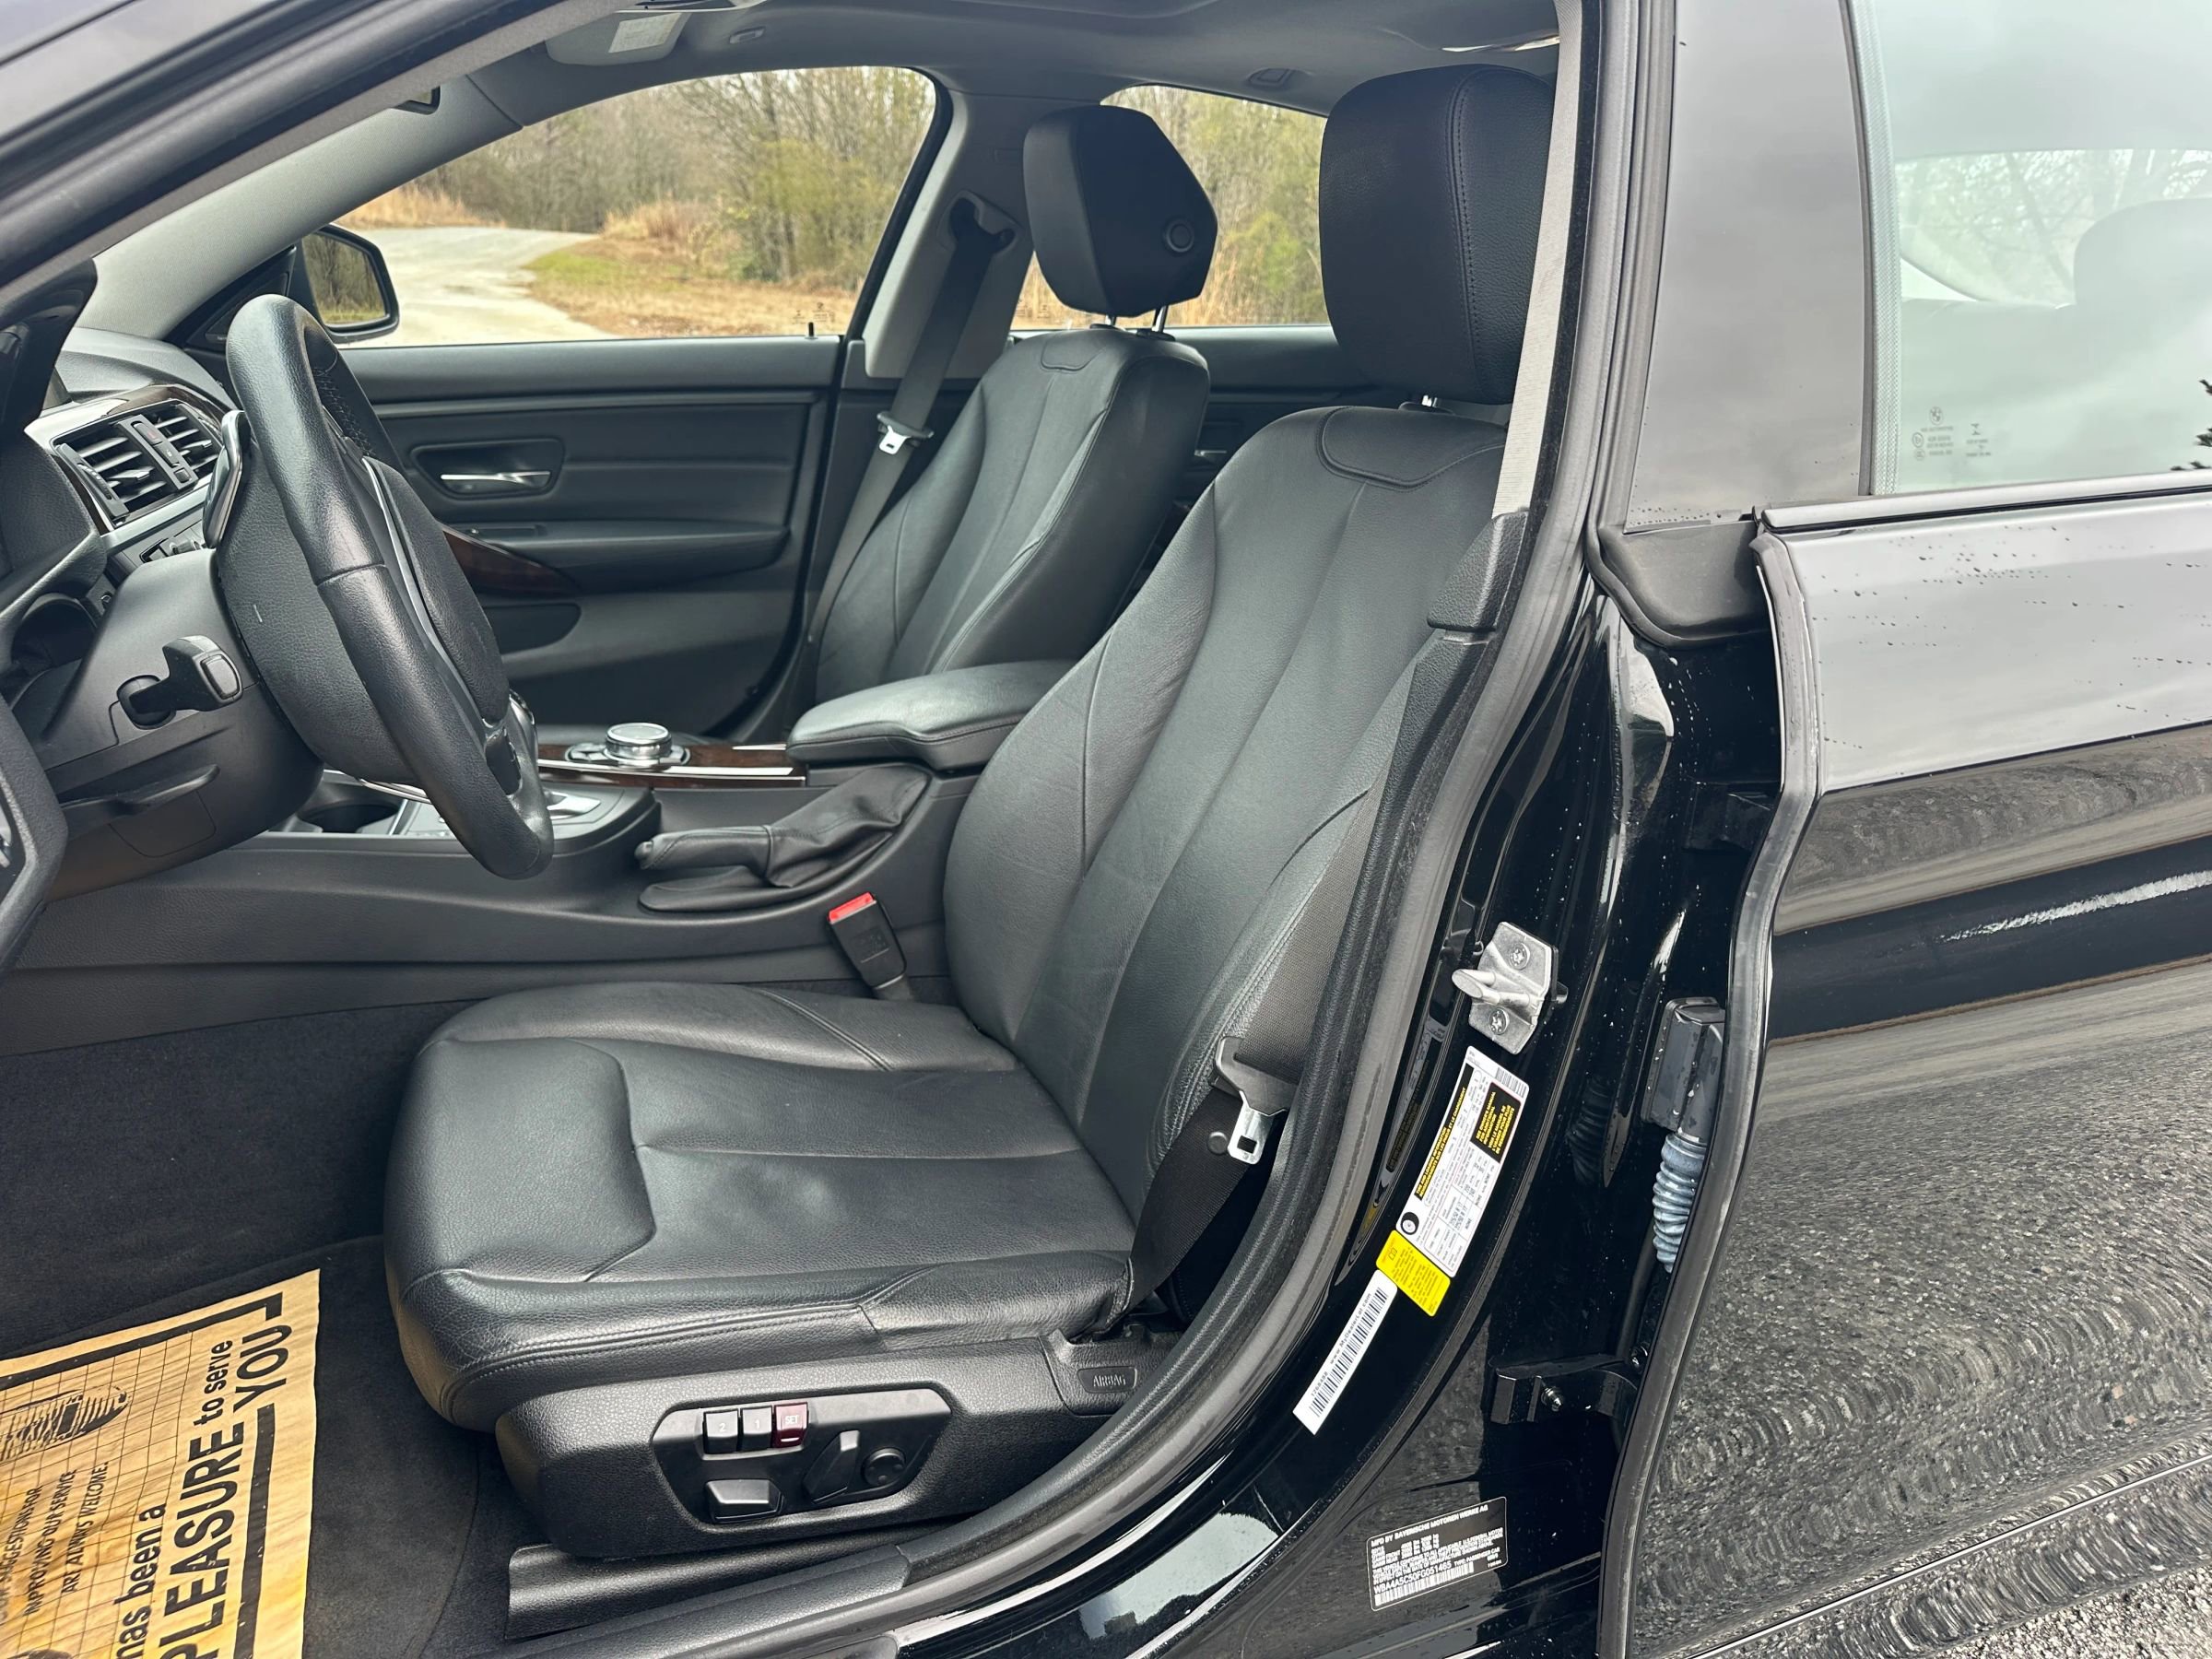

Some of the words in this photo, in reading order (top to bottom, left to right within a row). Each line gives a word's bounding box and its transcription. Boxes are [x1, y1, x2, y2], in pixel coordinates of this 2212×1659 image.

[204, 1339, 233, 1394] serve
[233, 1324, 292, 1414] YOU
[1093, 1374, 1126, 1388] AIRBAG
[194, 1396, 225, 1426] to
[719, 1422, 726, 1432] 2
[784, 1415, 800, 1425] SET
[51, 1469, 77, 1512] SERVICE
[41, 1509, 64, 1536] OUR
[1384, 1534, 1393, 1543] BY
[1479, 1503, 1488, 1512] AG
[65, 1520, 94, 1566] ALWAYS
[113, 1522, 163, 1605] been
[139, 1503, 166, 1522] a
[1490, 1546, 1500, 1554] CAR
[22, 1537, 55, 1617] IMPROVING
[62, 1569, 82, 1593] ARE
